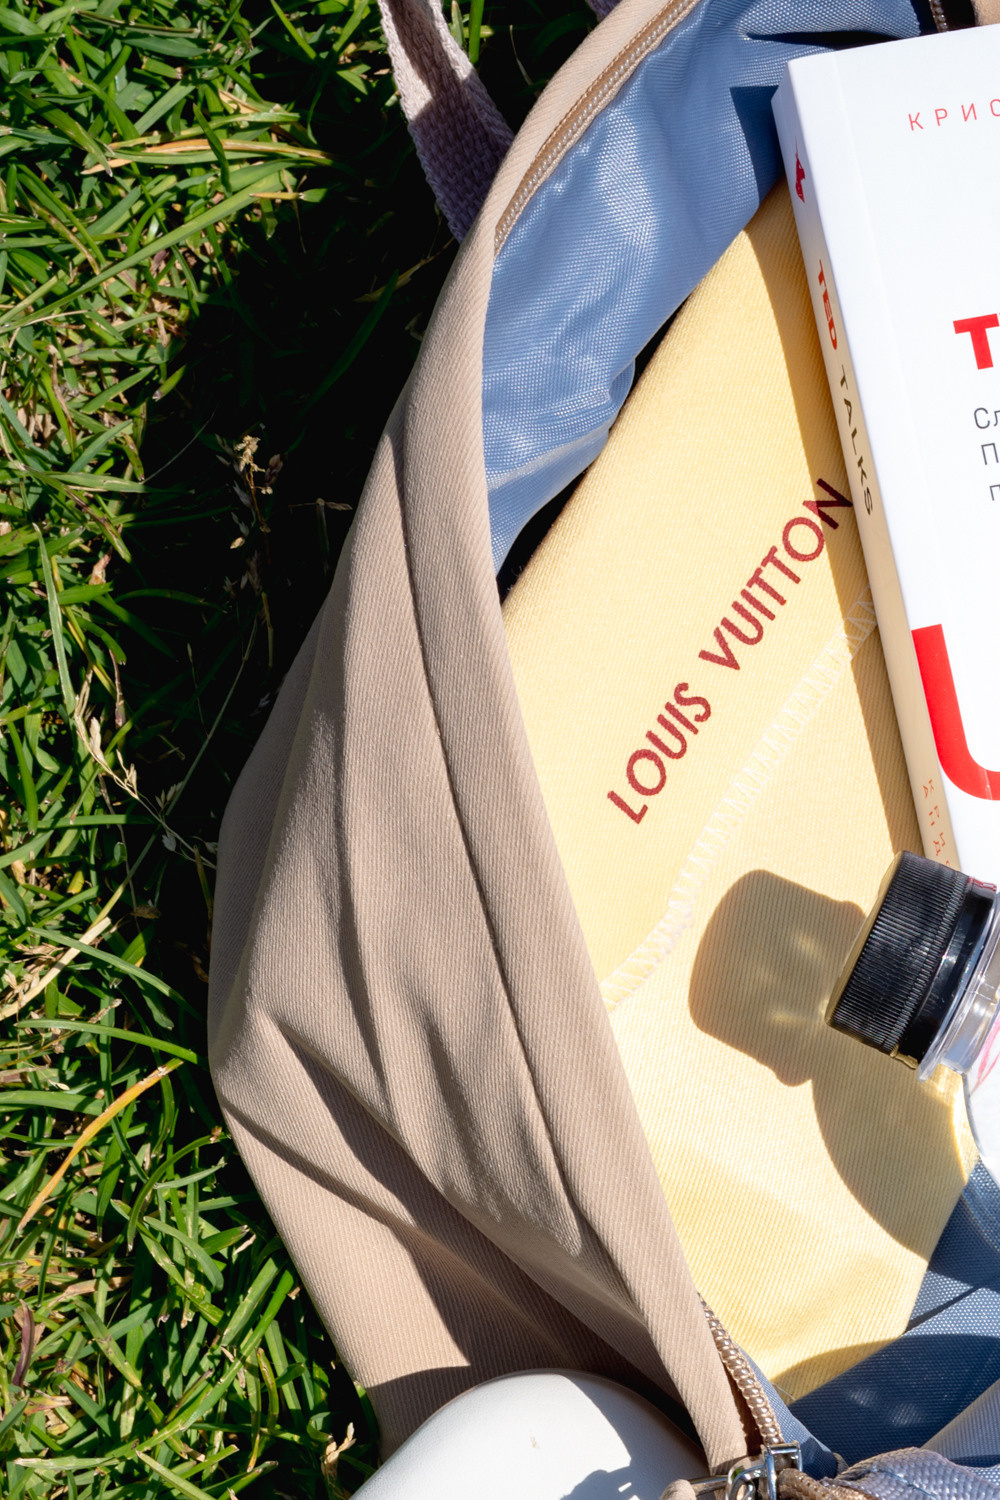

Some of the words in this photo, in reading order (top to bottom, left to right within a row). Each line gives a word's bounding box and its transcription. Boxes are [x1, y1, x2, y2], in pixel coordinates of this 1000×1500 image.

[819, 258, 838, 351] TED
[841, 364, 873, 516] TALKS
[606, 682, 712, 825] LOUIS
[697, 478, 856, 671] VUITTON
